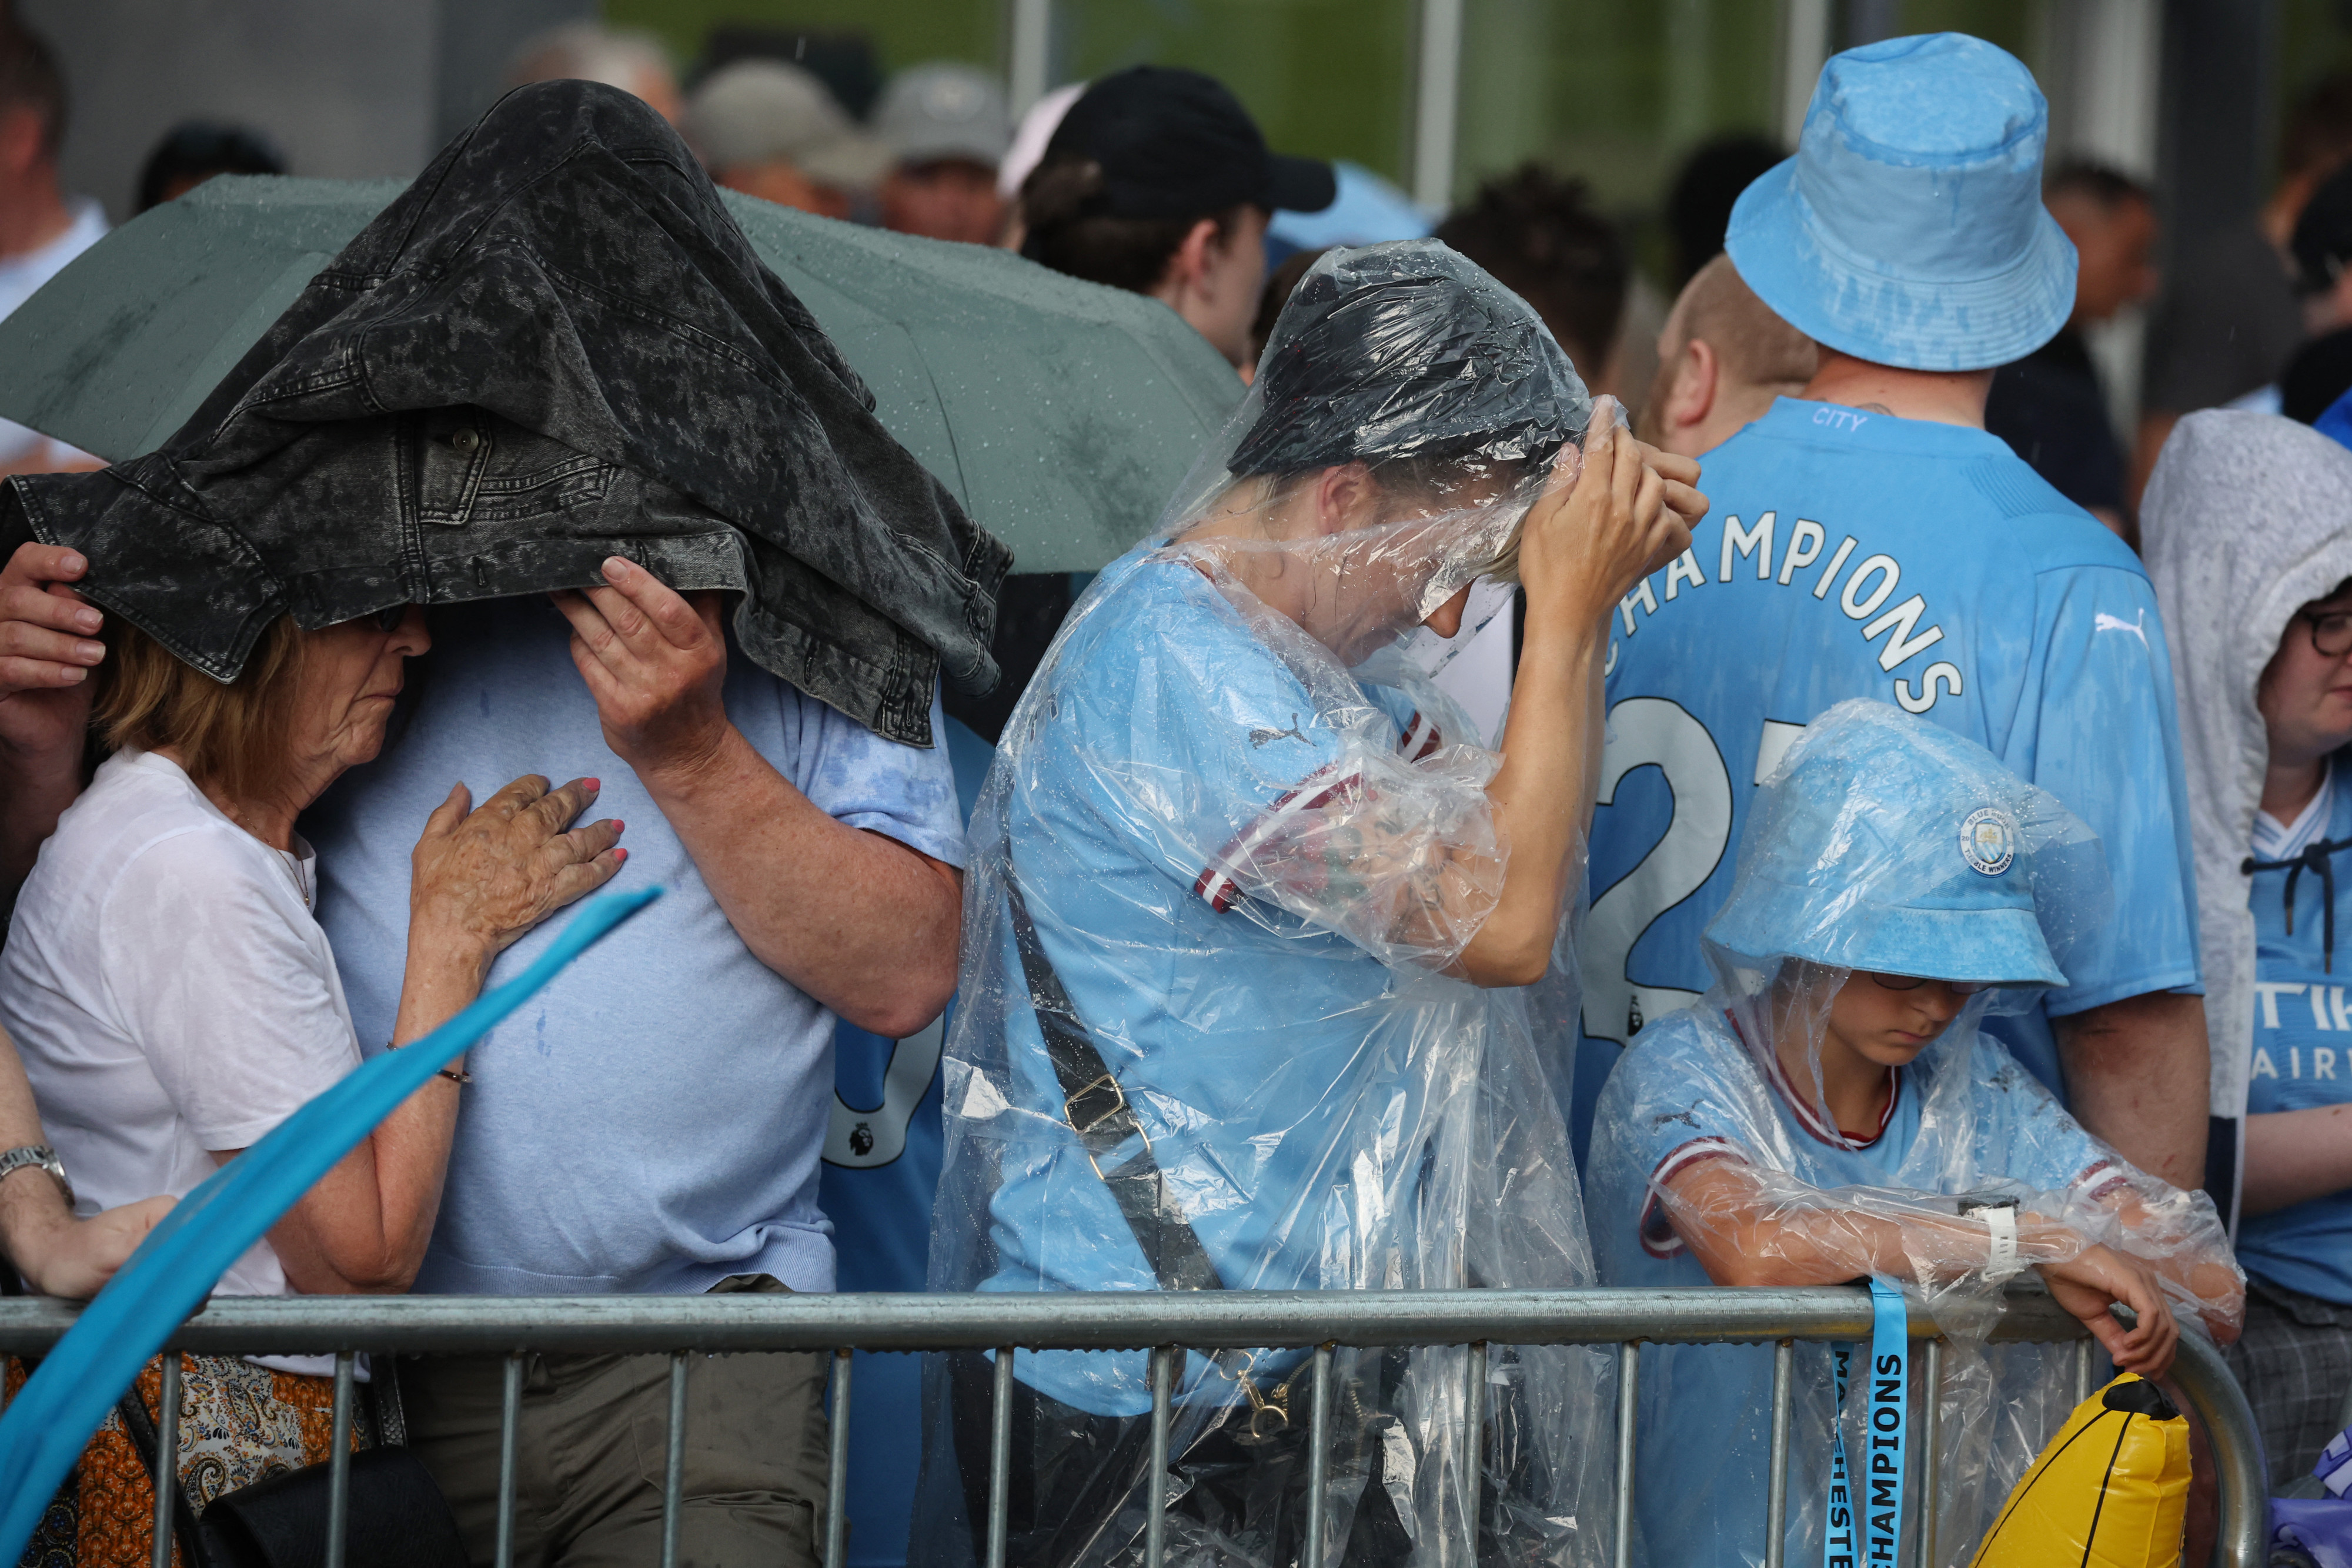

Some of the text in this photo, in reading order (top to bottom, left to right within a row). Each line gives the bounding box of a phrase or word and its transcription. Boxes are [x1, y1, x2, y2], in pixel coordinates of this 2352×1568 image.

[1812, 407, 1868, 432] CITY
[1967, 810, 1989, 825] BLUE
[1988, 854, 2012, 873] WINNERS
[2250, 1045, 2352, 1081] AIR
[1871, 1354, 1902, 1568] HAMPIONS
